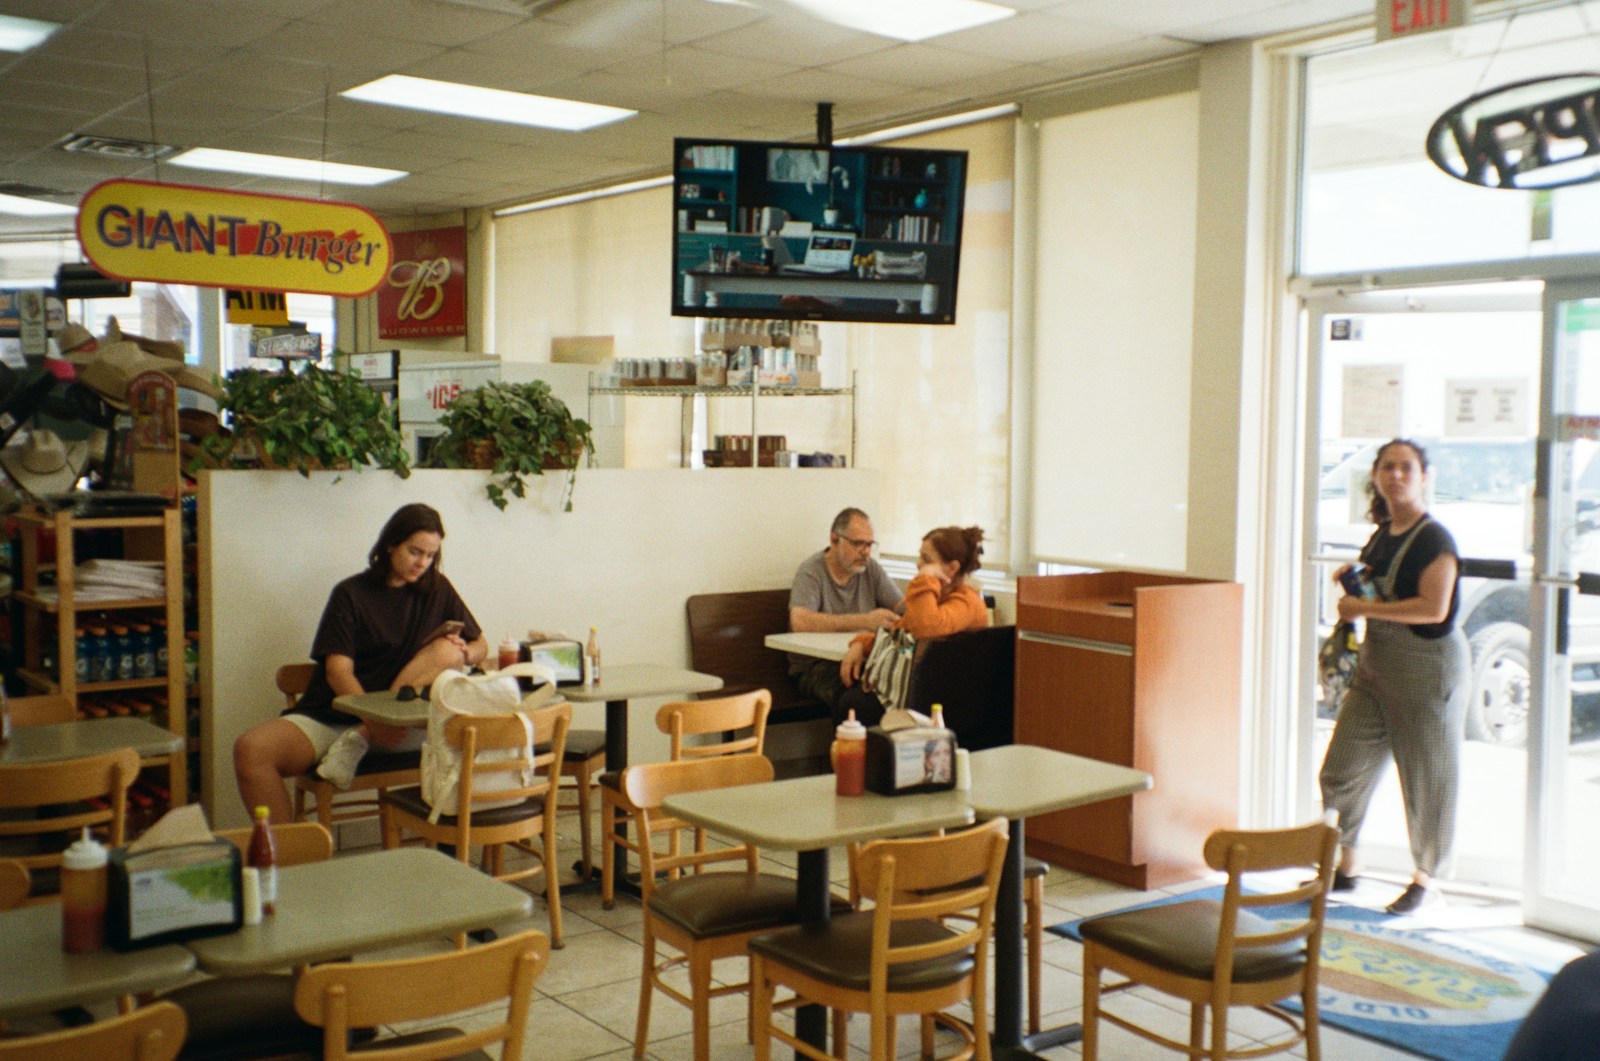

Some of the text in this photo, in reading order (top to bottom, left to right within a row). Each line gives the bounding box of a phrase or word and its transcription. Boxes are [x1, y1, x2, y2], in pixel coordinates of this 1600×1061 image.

[1389, 0, 1449, 33] EXIT
[96, 204, 381, 274] GIANT Burger
[380, 325, 465, 336] BUDWEISER
[432, 383, 461, 410] ICE
[1352, 1001, 1430, 1020] OLD
